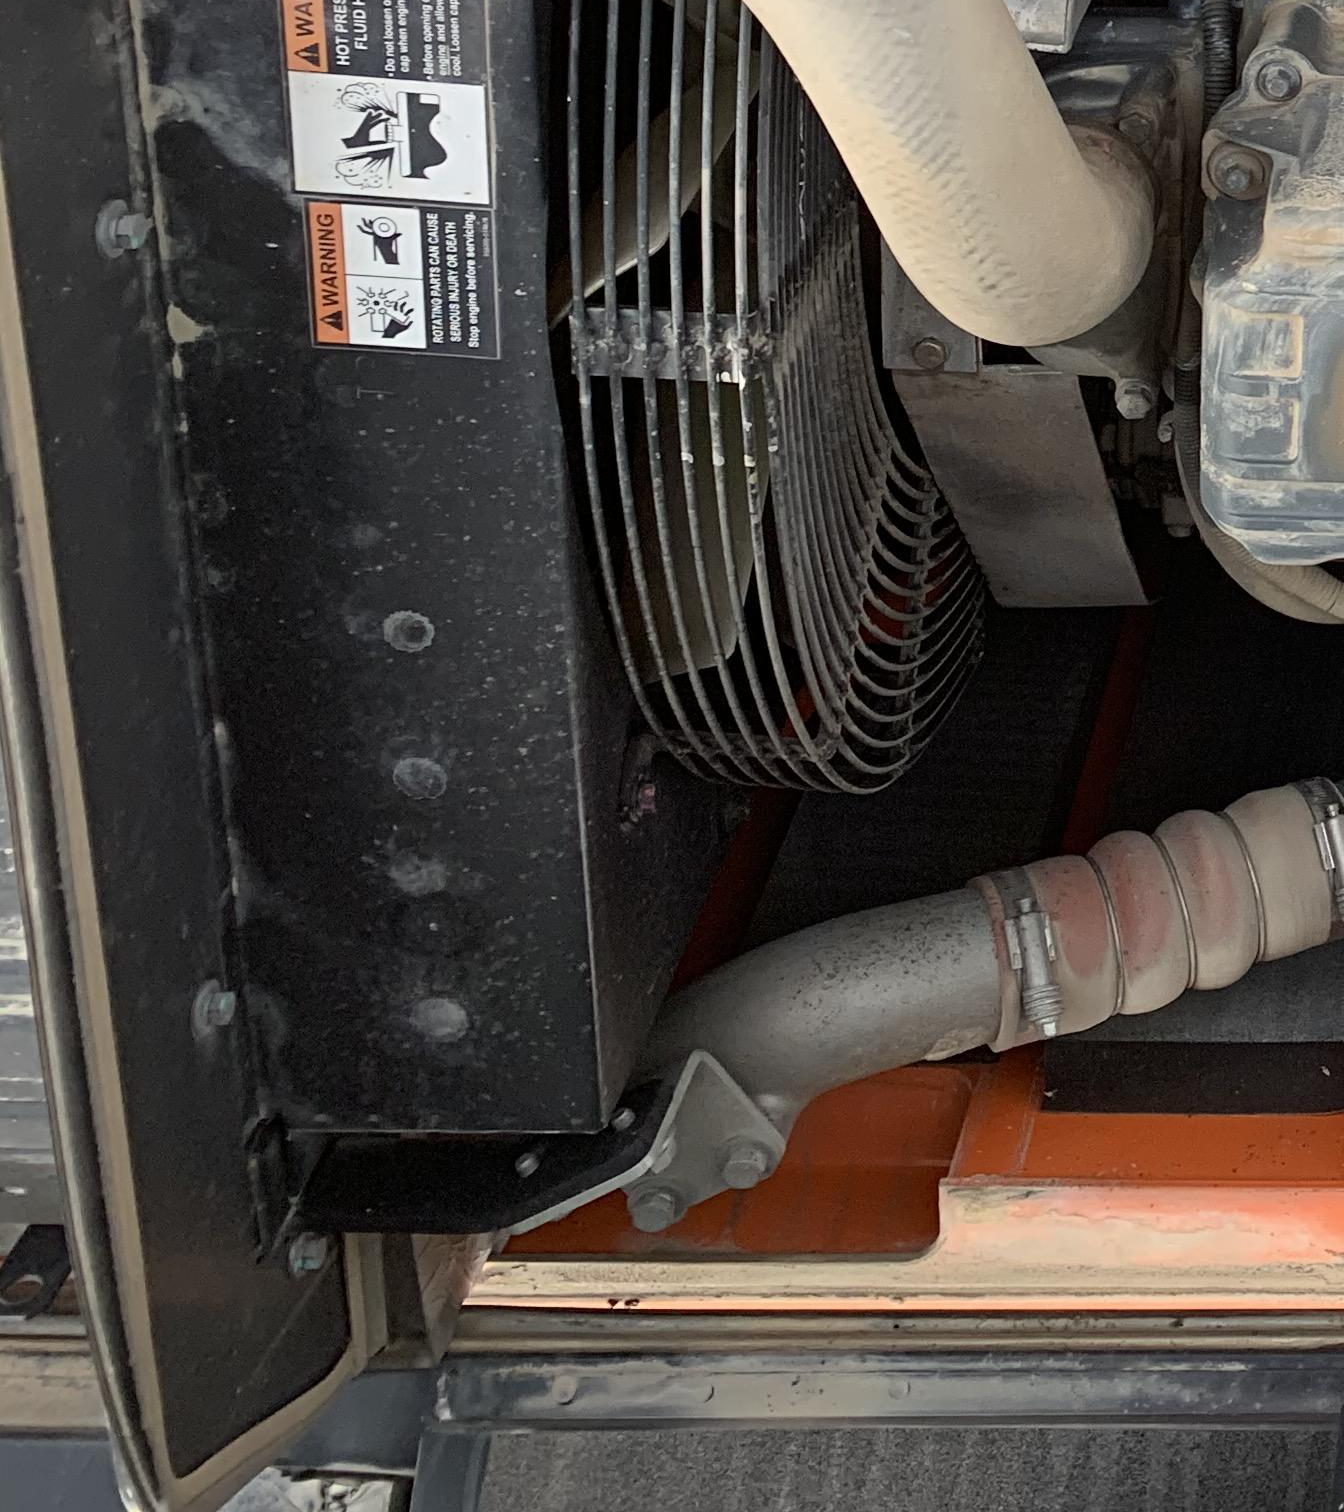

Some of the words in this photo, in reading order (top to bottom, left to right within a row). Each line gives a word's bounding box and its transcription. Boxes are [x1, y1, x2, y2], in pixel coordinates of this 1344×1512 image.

[354, 9, 368, 50] FLUID
[382, 7, 393, 41] loosen
[420, 7, 433, 47] opening
[434, 24, 446, 43] and
[449, 17, 460, 52] Loosen
[335, 35, 350, 66] HOT
[383, 42, 394, 58] not
[399, 30, 408, 53] when
[385, 59, 395, 72] Do
[400, 55, 410, 73] cap
[423, 49, 434, 74] Before
[437, 45, 450, 76] engine
[426, 212, 439, 244] CAUSE
[445, 222, 457, 256] DEATH
[317, 213, 340, 307] WARNING
[428, 245, 440, 264] CAN
[446, 256, 458, 274] OR
[429, 265, 442, 296] PARTS
[466, 259, 477, 289] before
[447, 275, 460, 305] INJURY
[431, 296, 444, 343] ROTATING
[467, 291, 480, 325] engine
[449, 306, 461, 342] SERIOUS
[468, 326, 480, 348] Stop
